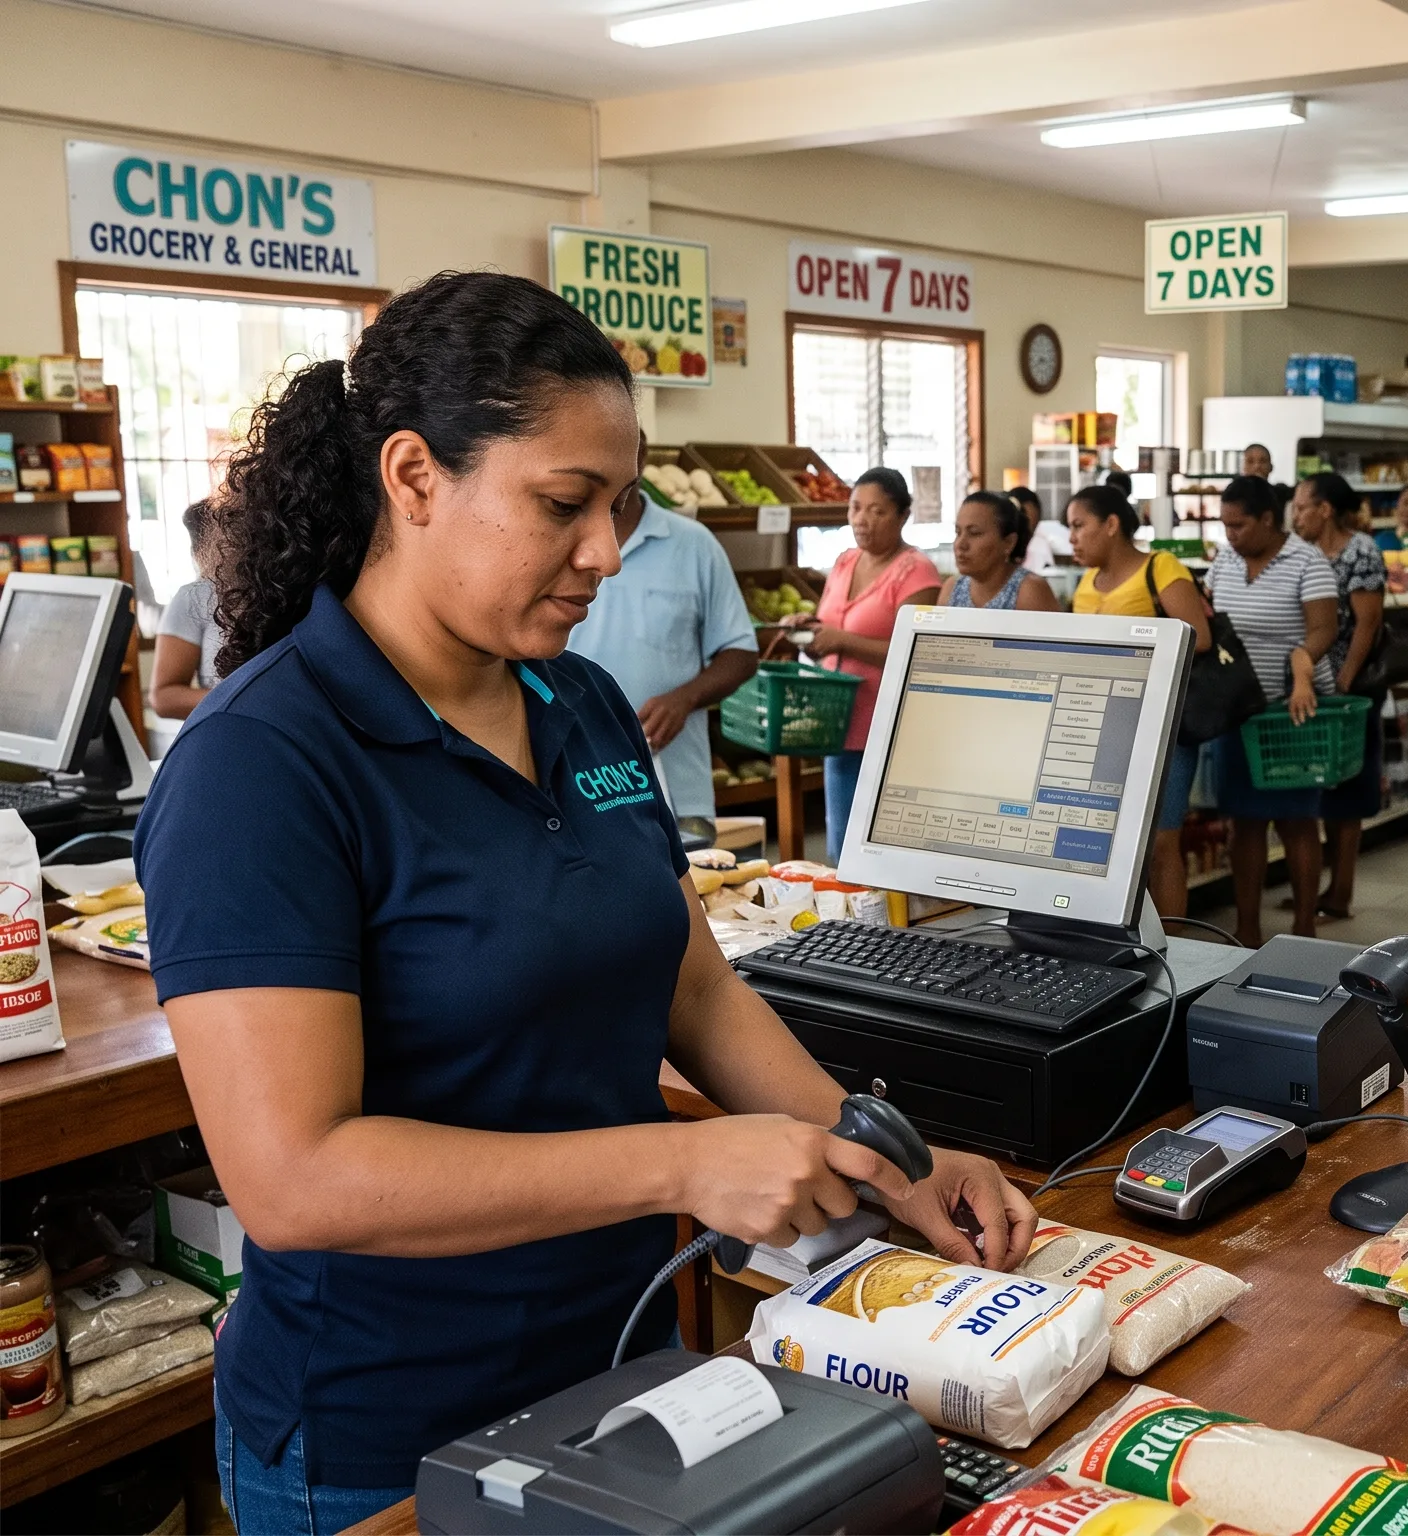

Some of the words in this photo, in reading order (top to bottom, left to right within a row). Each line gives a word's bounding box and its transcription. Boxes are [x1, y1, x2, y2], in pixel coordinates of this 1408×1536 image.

[113, 156, 336, 237] CHON'S
[90, 222, 214, 263] GROCERY
[224, 235, 242, 266] &
[250, 238, 360, 276] GENERAL
[583, 240, 681, 288] FRESH
[1170, 225, 1262, 261] OPEN
[796, 254, 869, 302] OPEN
[876, 257, 902, 313] 7
[909, 269, 970, 313] DAYS
[1157, 271, 1175, 301] 7
[1188, 265, 1275, 300] DAYS
[561, 285, 703, 335] PRODUCE
[575, 760, 649, 800] CHON'S
[957, 1280, 1048, 1336] FLOUR
[826, 1353, 909, 1401] FLOUR
